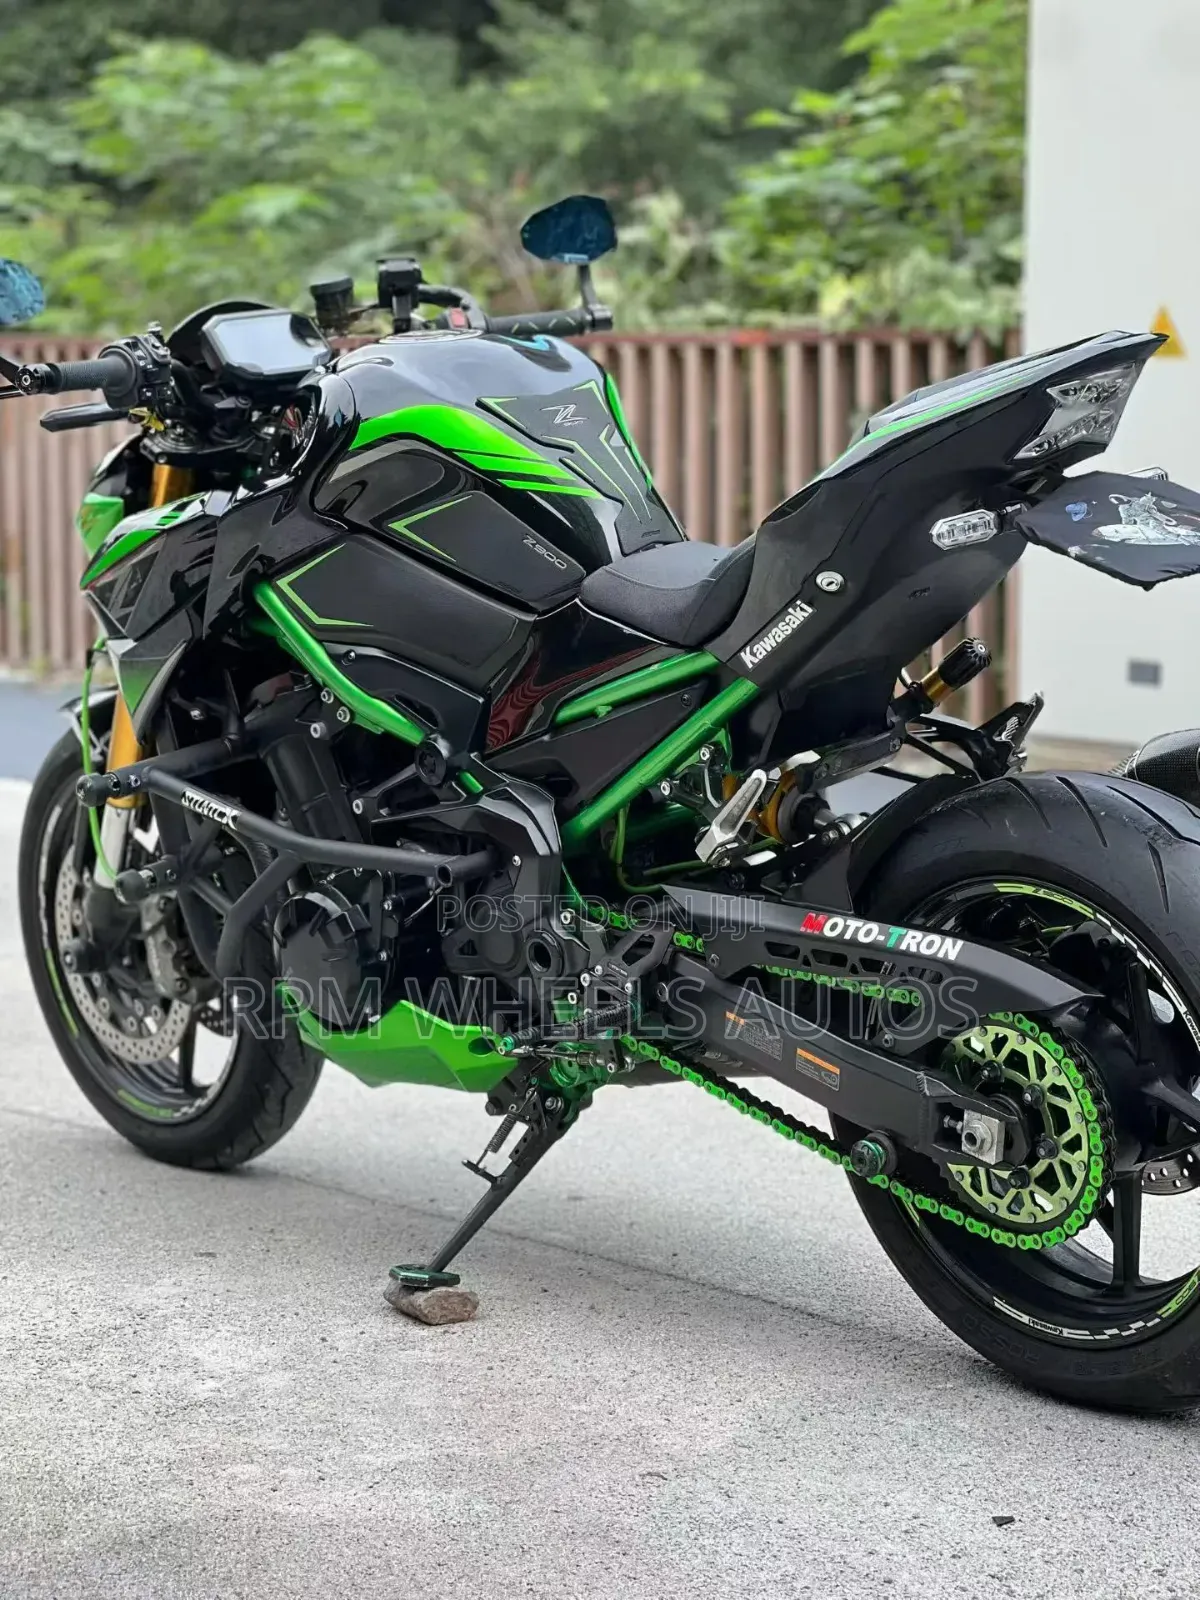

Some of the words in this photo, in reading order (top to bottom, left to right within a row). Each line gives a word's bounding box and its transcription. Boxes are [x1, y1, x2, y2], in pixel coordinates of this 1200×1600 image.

[522, 534, 567, 569] Z900
[740, 600, 813, 669] Kawasaki
[800, 912, 963, 961] MOTO-TRON
